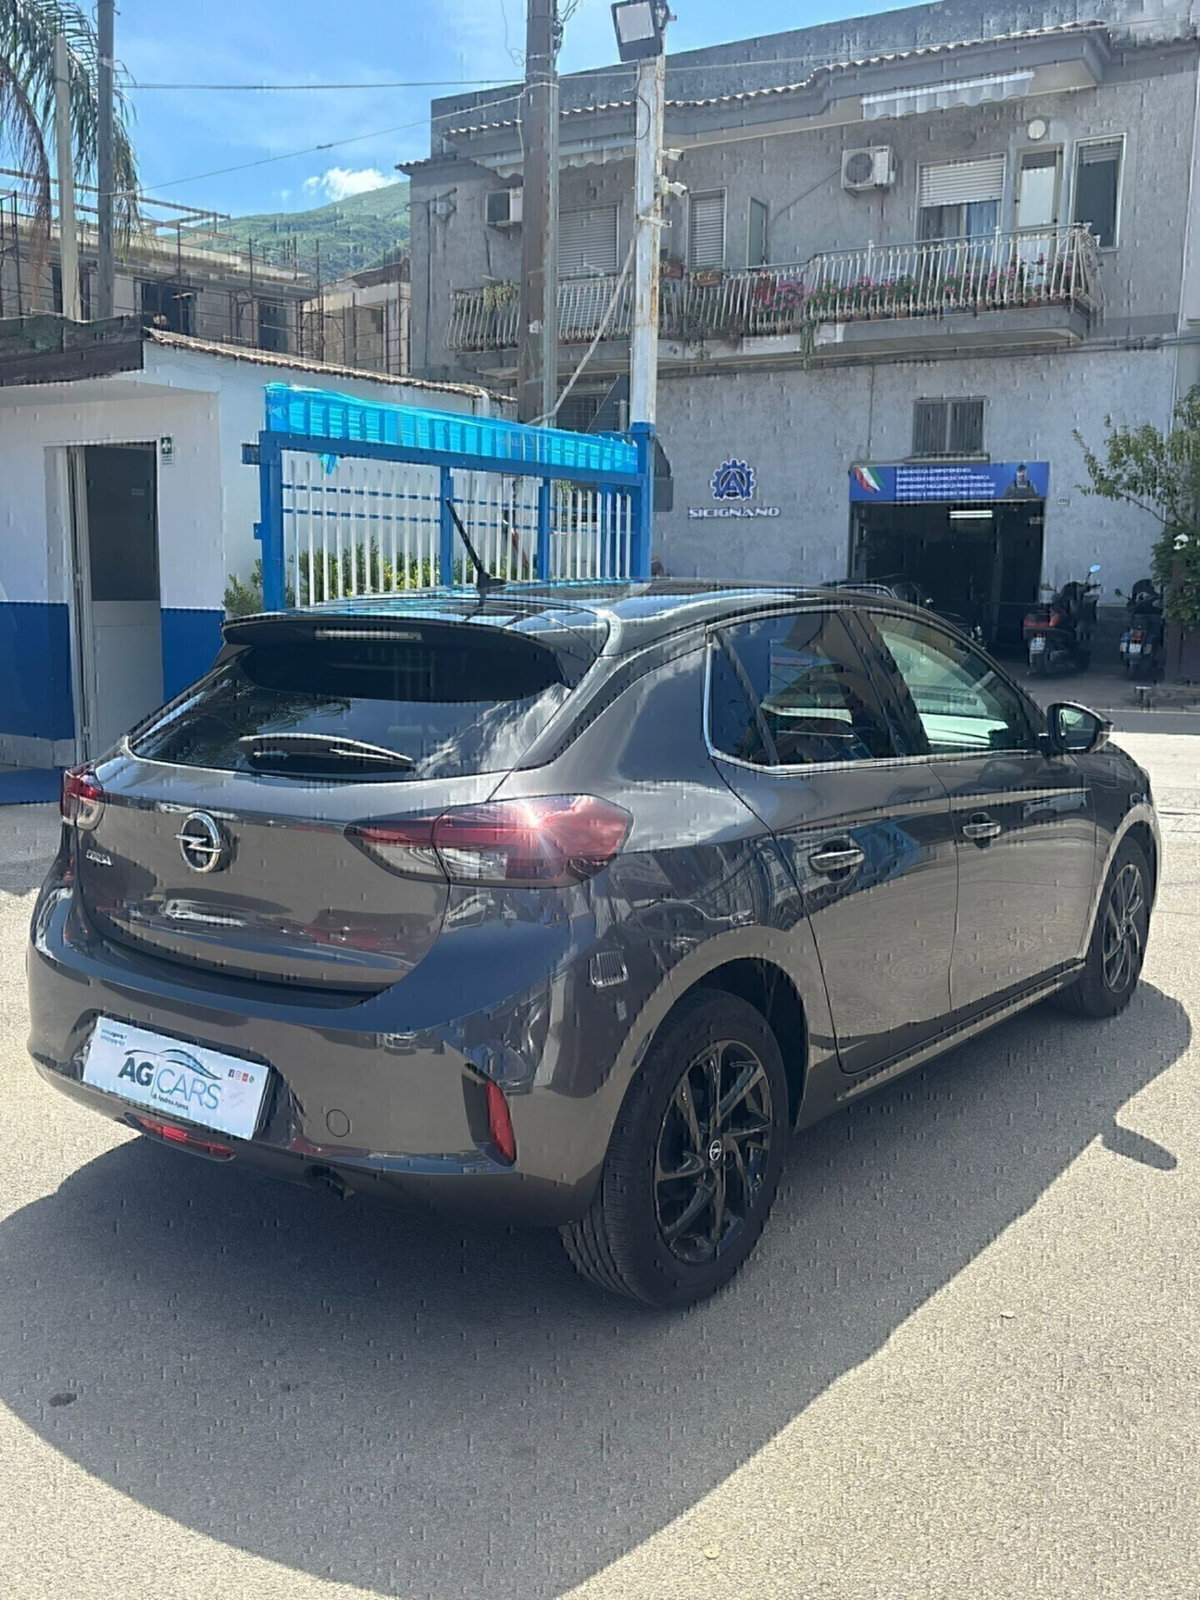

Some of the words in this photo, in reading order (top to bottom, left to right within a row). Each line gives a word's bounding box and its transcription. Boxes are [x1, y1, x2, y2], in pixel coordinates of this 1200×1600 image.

[689, 507, 781, 519] SICIGNANO
[118, 1057, 155, 1087] AG
[156, 1068, 222, 1110] CARS
